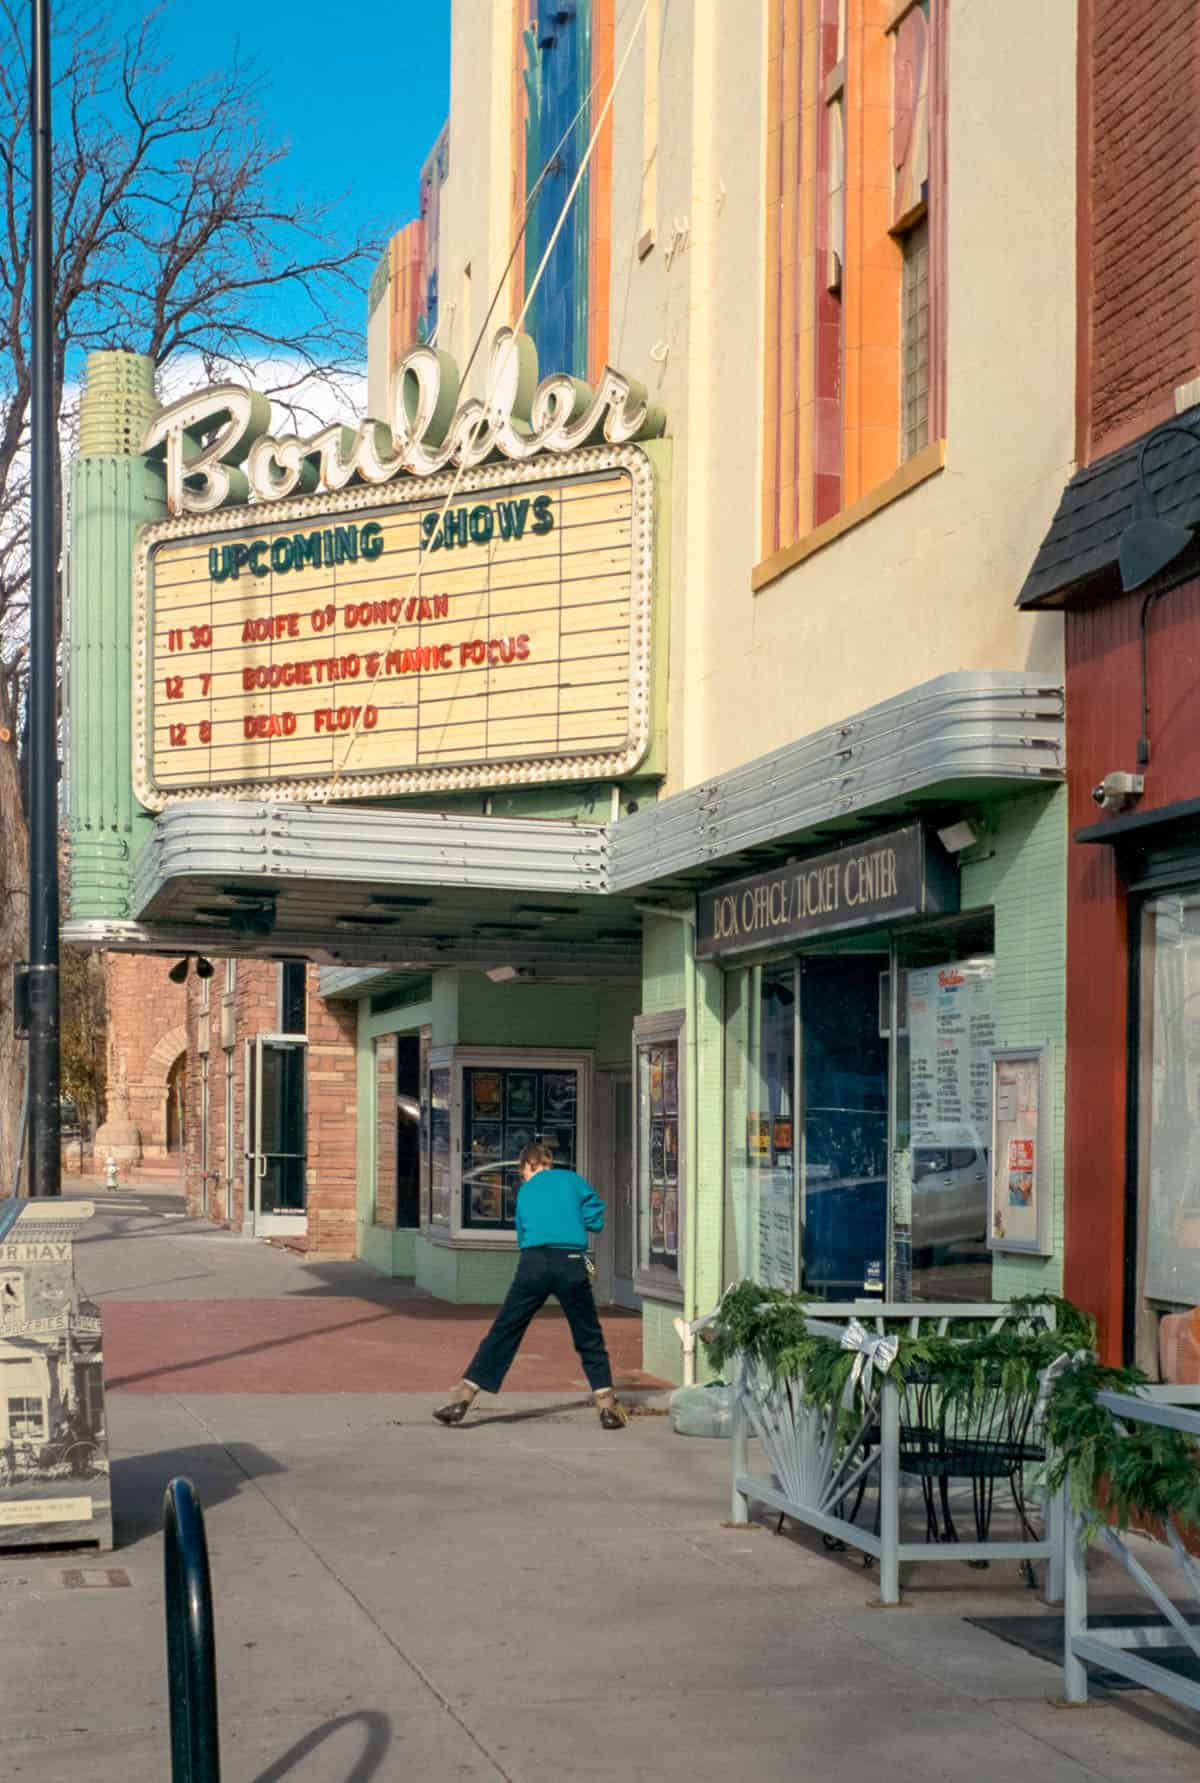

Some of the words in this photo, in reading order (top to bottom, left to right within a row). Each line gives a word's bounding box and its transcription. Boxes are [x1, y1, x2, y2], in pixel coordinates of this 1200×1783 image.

[142, 326, 649, 517] Boulder
[208, 522, 384, 581] UPCOMING
[420, 495, 555, 552] SHOWS
[167, 628, 184, 652] 11
[189, 624, 213, 650] 30
[241, 613, 299, 642] AOIFE
[344, 593, 449, 629] DONOVAN
[165, 675, 184, 699] 12
[199, 673, 212, 697] 7
[385, 642, 453, 675] MANIC
[459, 633, 531, 668] FOCUS
[168, 723, 187, 746] 12
[198, 720, 212, 744] 8
[243, 711, 296, 739] DEAD
[313, 704, 379, 733] FLOYD
[713, 895, 739, 940] BOX
[844, 848, 898, 907] CENTER
